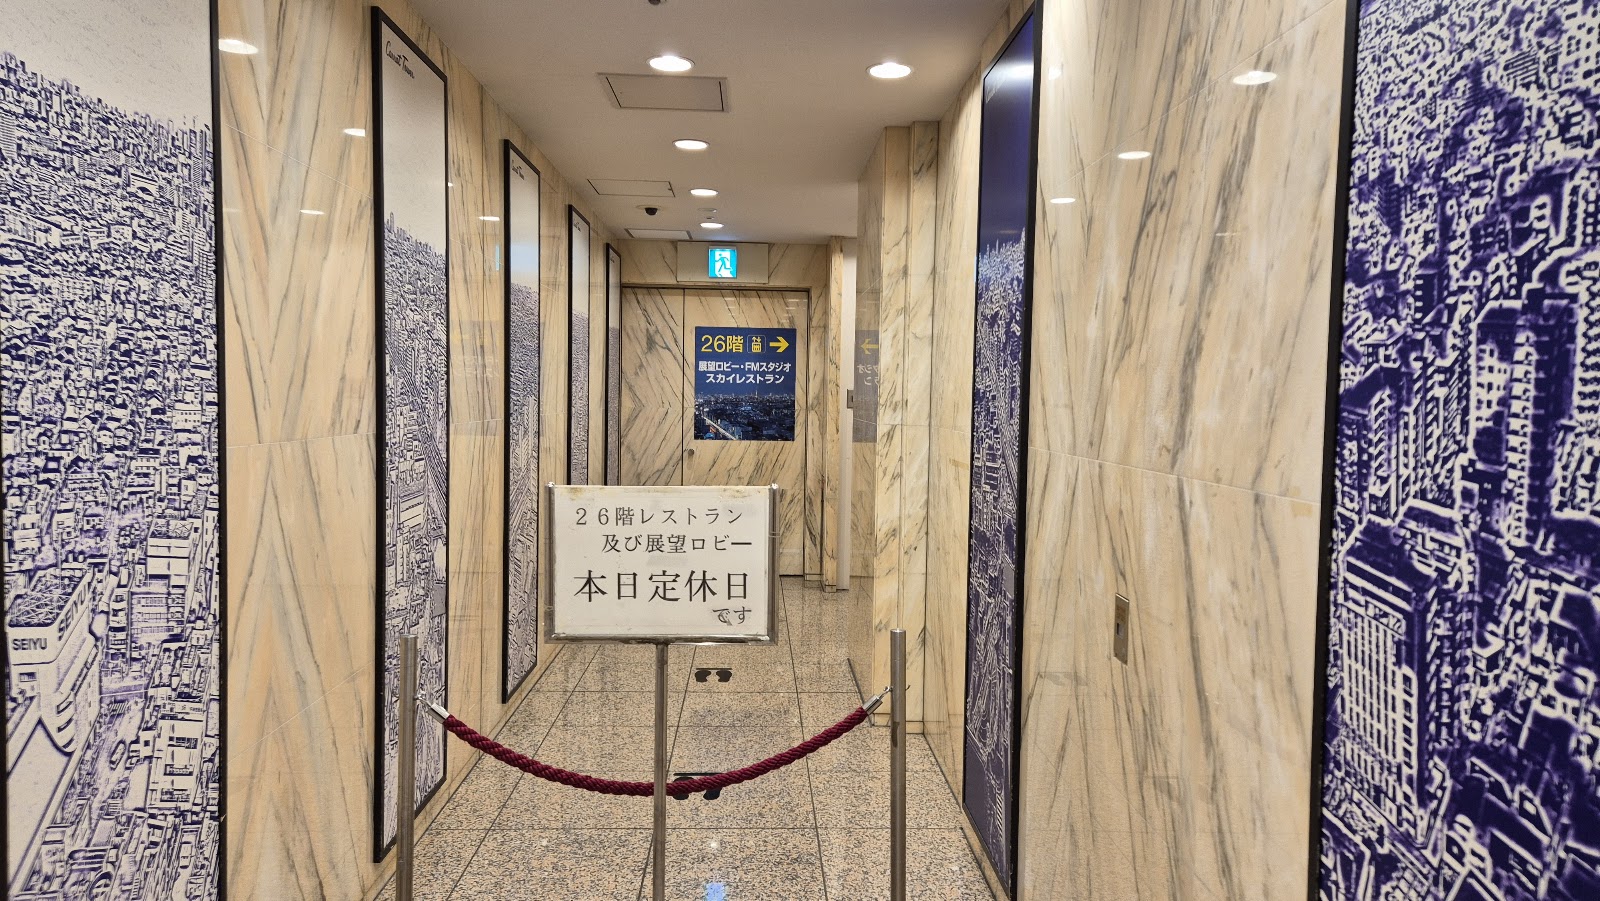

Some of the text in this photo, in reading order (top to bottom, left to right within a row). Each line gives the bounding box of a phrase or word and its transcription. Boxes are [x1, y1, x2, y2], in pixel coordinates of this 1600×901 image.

[701, 335, 743, 353] 26階
[698, 361, 791, 372] 展望ロビー・FMスタジオ
[706, 373, 784, 384] スカイレストラン
[601, 534, 752, 553] 及び展望ロビー
[573, 570, 748, 603] 本日定休日
[712, 606, 752, 626] です
[12, 638, 48, 650] SEIYU
